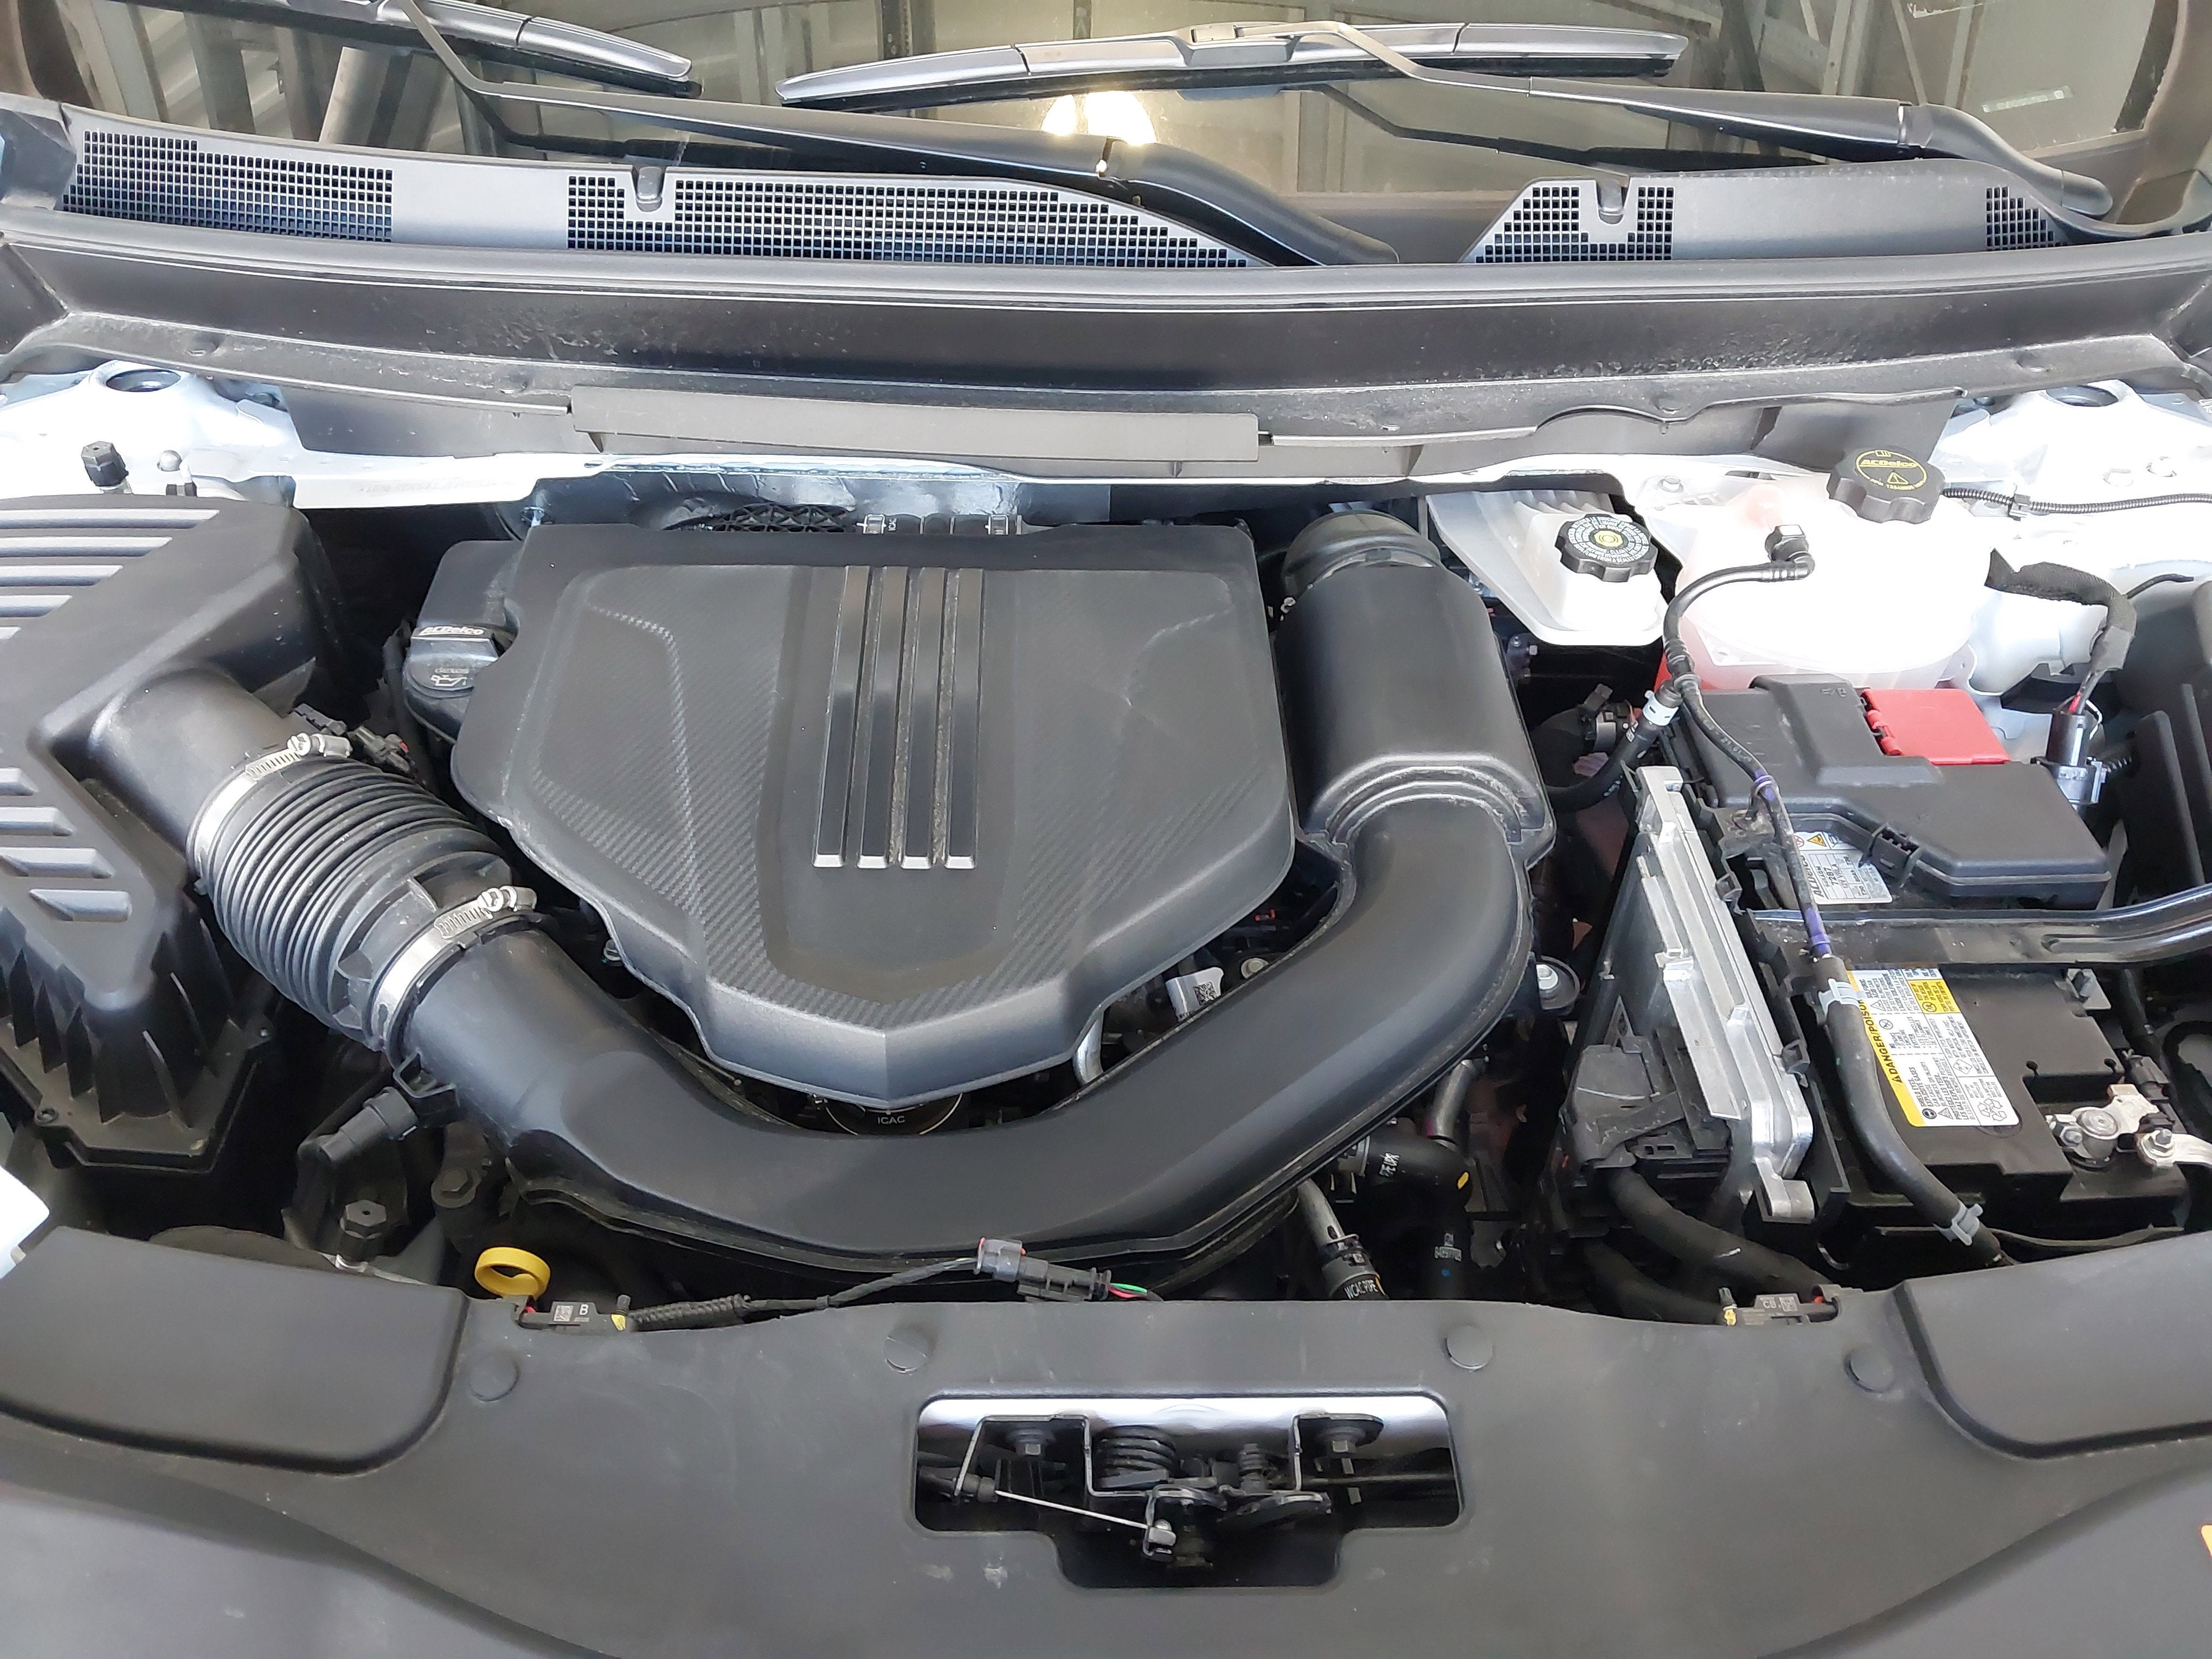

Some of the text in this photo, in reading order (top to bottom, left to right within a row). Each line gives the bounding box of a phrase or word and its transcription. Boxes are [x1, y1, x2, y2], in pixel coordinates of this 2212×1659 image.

[1861, 459, 1918, 467] ACDelco
[418, 626, 484, 636] ACDelco
[877, 1115, 905, 1124] ICAC
[578, 1304, 589, 1316] B
